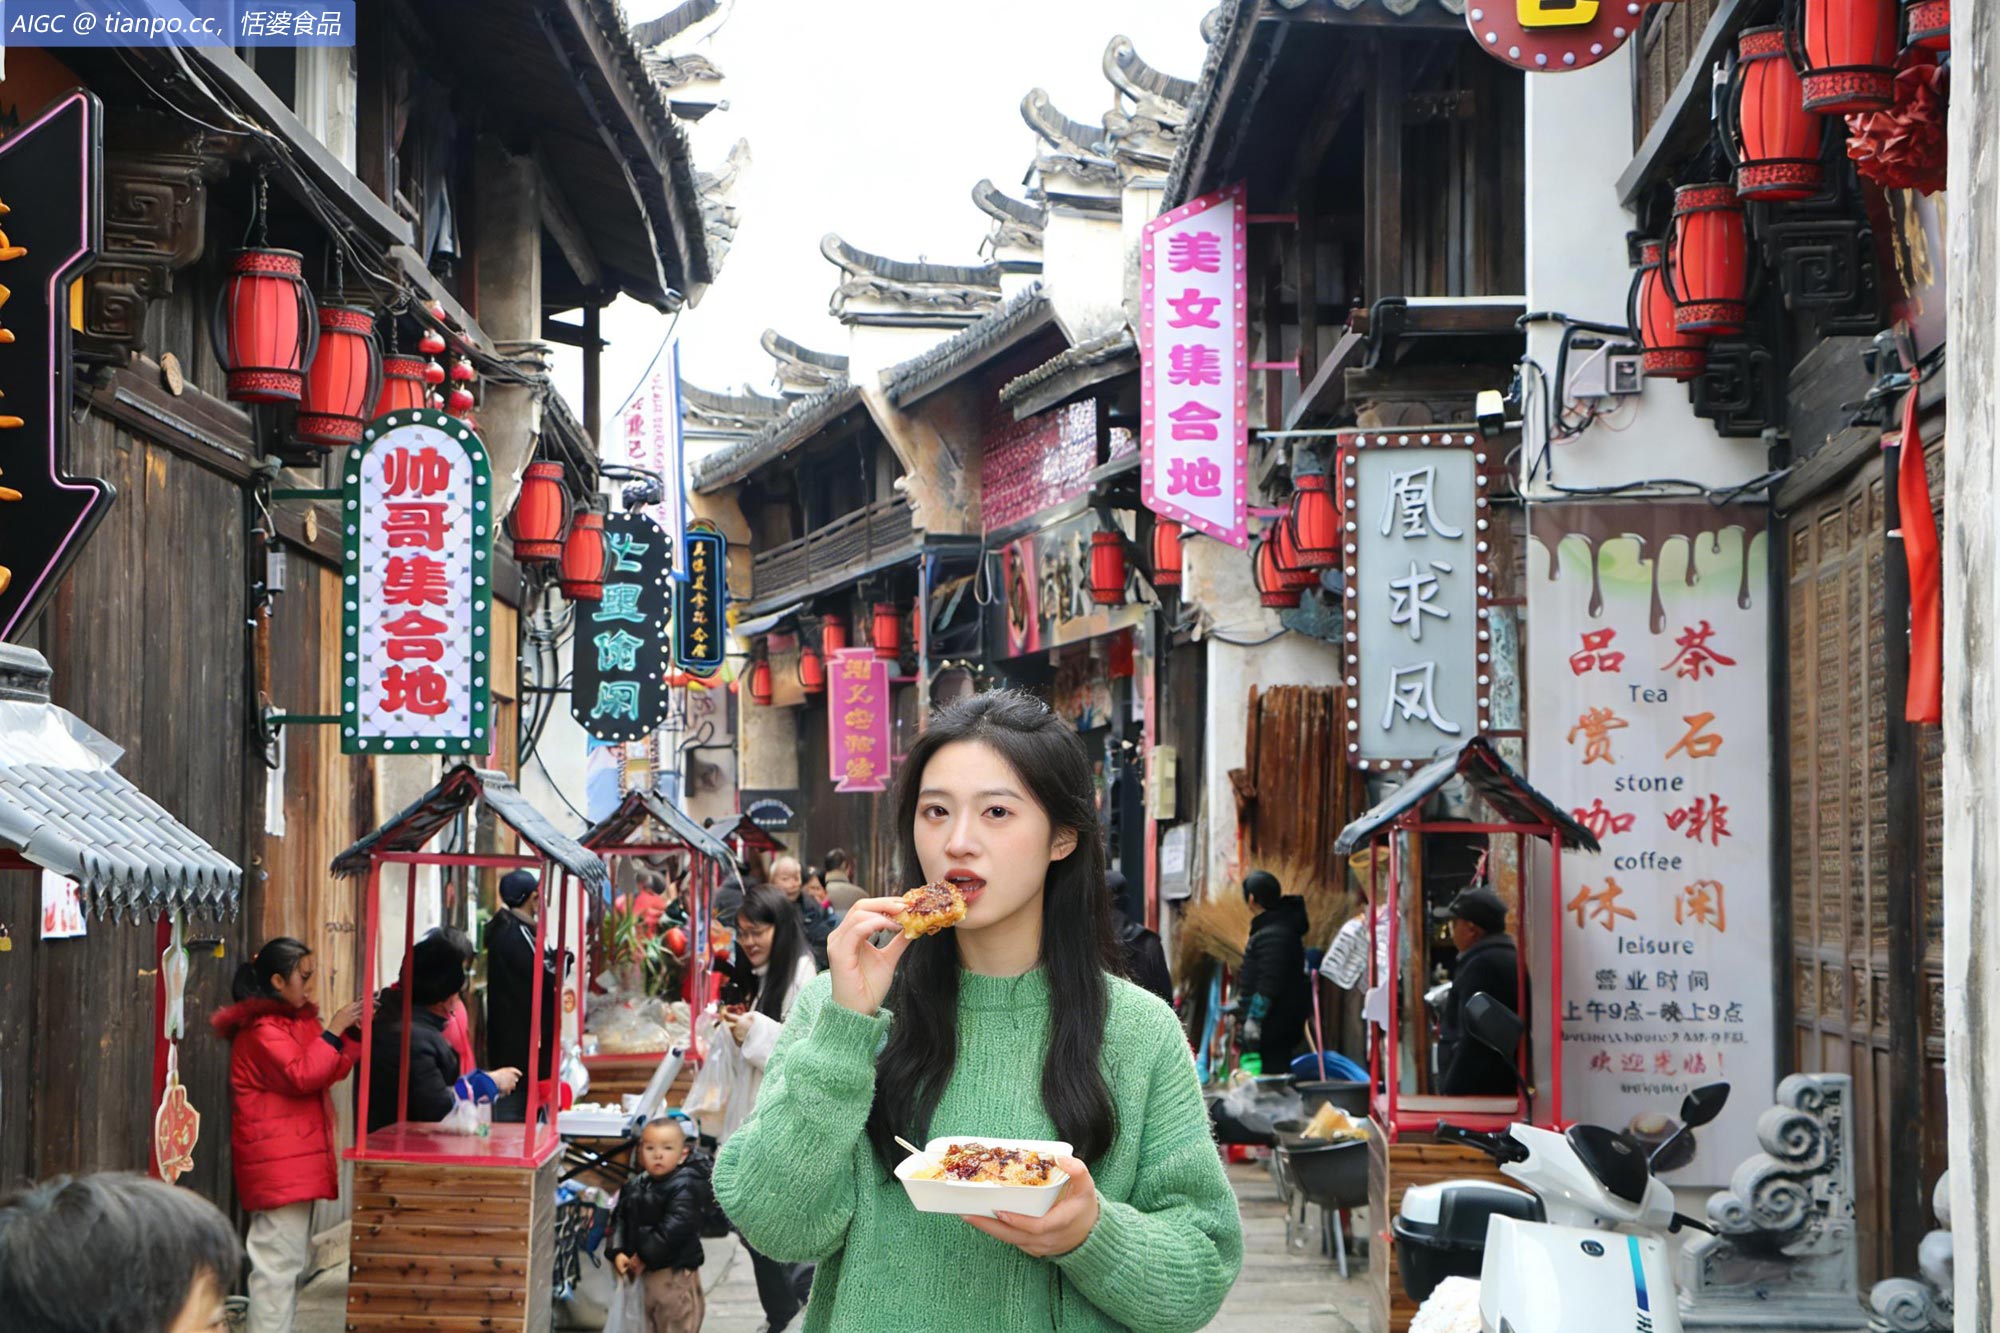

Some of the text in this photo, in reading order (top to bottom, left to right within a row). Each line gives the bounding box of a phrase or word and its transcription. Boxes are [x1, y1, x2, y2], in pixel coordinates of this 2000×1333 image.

[1166, 231, 1223, 497] 美女集合地
[379, 446, 451, 716] 帅哥集合地
[1380, 464, 1464, 734] 凰求凤
[1568, 620, 1737, 682] 品茶
[1628, 684, 1668, 703] Tea
[1567, 707, 1723, 765] 赏石
[1615, 776, 1684, 792] stone
[1571, 793, 1732, 847] 咖啡
[1614, 851, 1682, 871] coffee
[1567, 876, 1726, 933] 休闲
[1618, 936, 1694, 955] leisure
[1595, 969, 1709, 992] 营业时间
